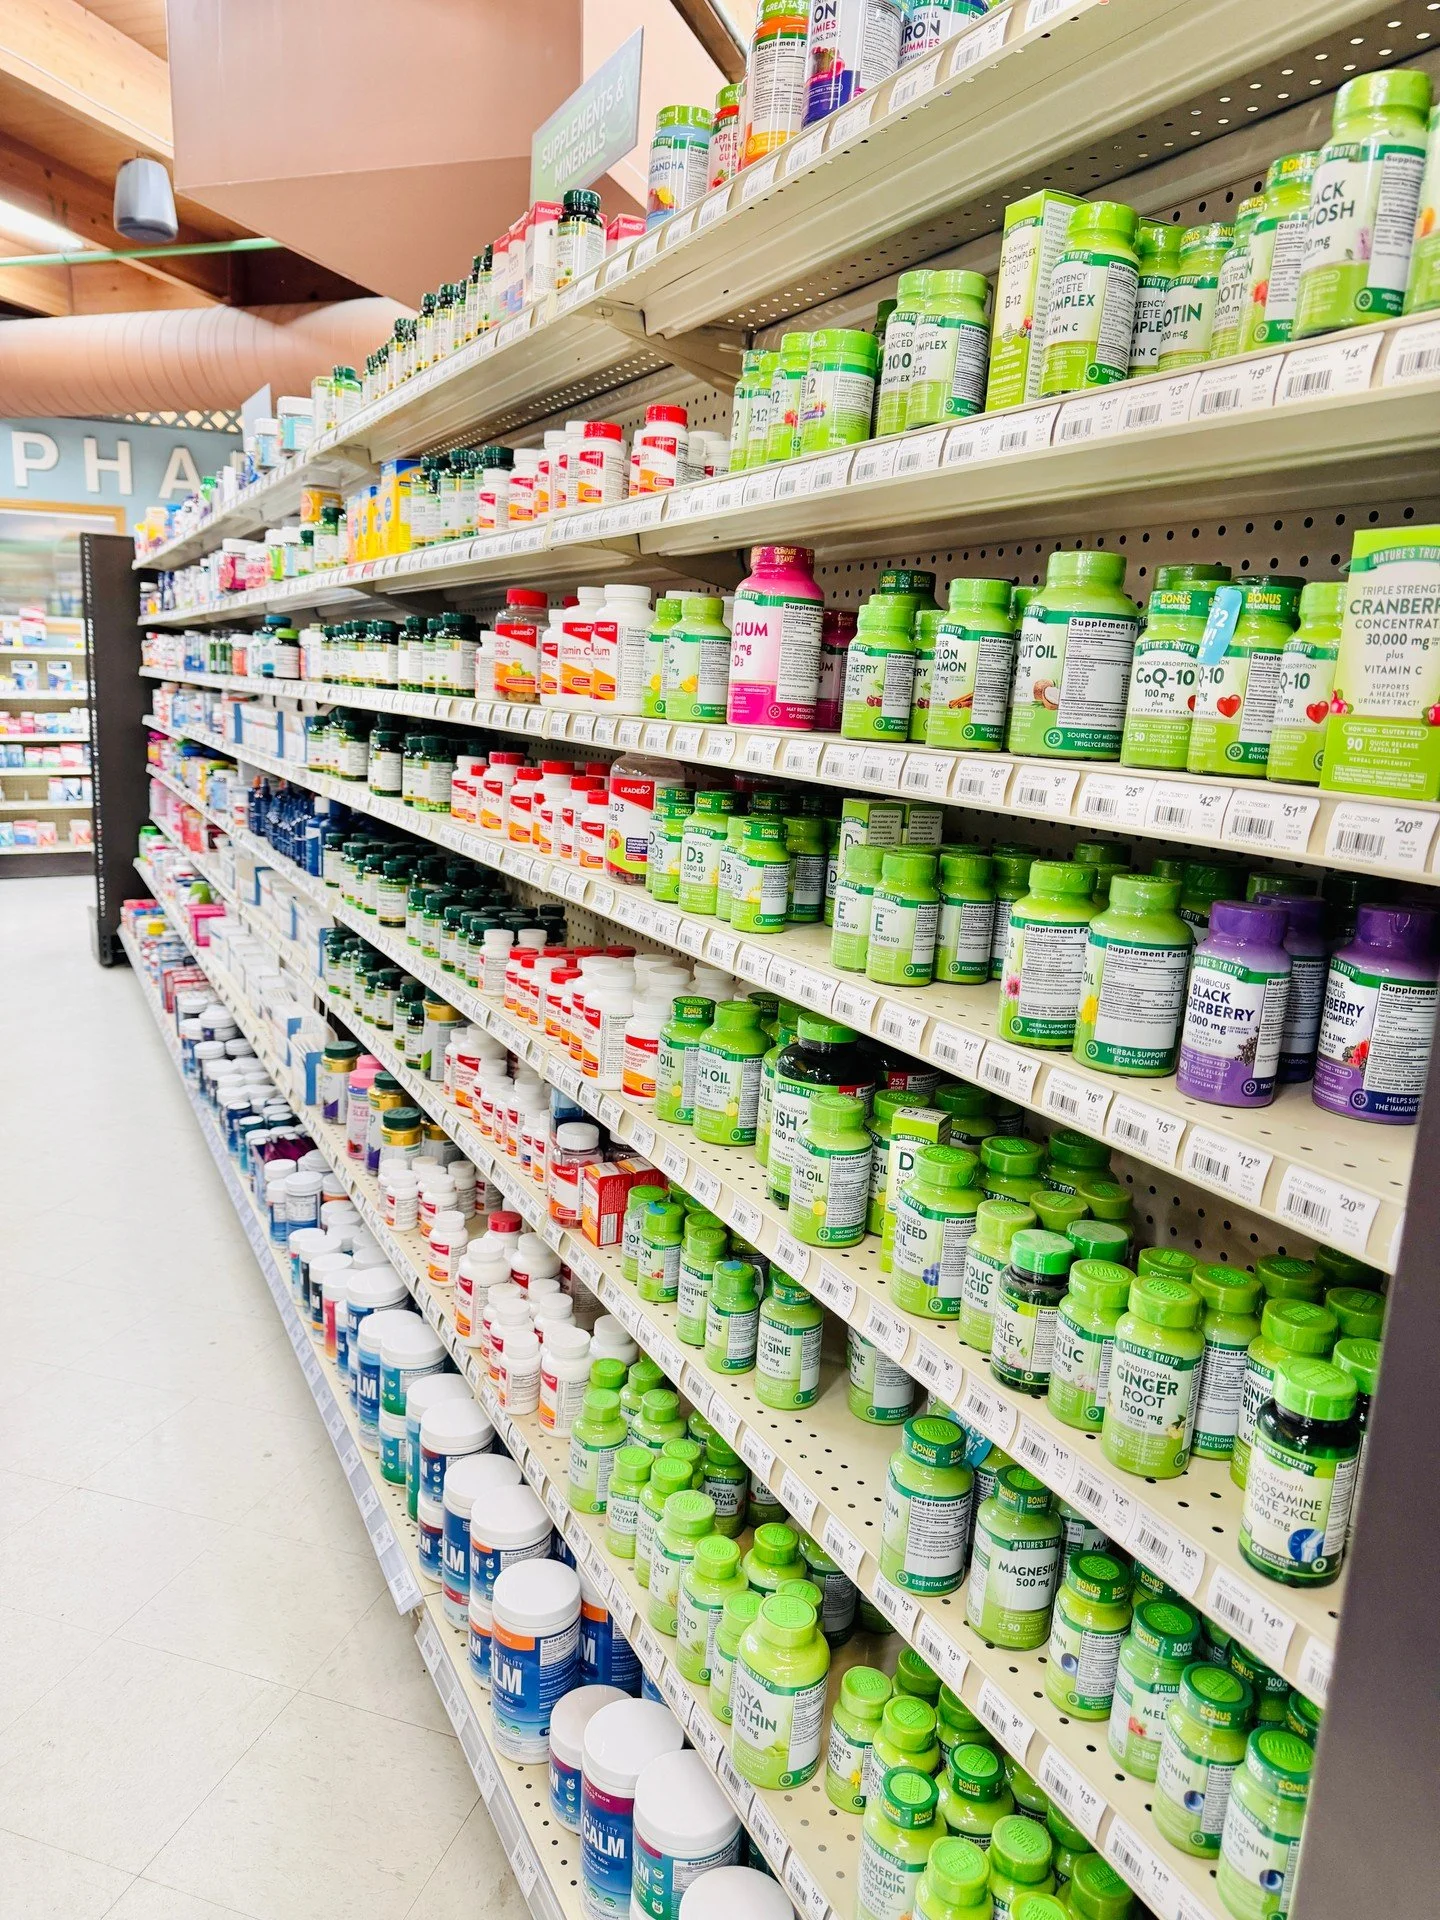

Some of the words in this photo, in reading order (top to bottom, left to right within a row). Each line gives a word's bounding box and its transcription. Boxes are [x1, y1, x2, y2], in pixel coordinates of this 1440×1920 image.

[900, 20, 941, 46] IRON
[900, 39, 941, 56] GUMMIES
[541, 86, 615, 171] SUPPLEMENTS
[614, 75, 626, 105] &
[554, 123, 607, 187] MINERALS
[1001, 246, 1037, 268] B-COMPLEX
[1004, 260, 1029, 277] LIQUID
[1004, 294, 1022, 309] B-12
[1373, 548, 1415, 565] NATURE'S
[1362, 586, 1394, 596] TRIPLE
[1160, 594, 1192, 605] BONUS
[1246, 594, 1282, 605] BONUS
[1071, 618, 1129, 632] Supplement
[739, 643, 753, 657] mg
[1141, 640, 1173, 654] NATURE'S
[1365, 633, 1408, 649] 30,000
[1410, 637, 1430, 652] mg
[1035, 645, 1058, 661] OIL
[1385, 650, 1404, 663] plus
[1161, 659, 1199, 669] ABSORPTION
[1364, 664, 1412, 677] VITAMIN
[1413, 667, 1423, 678] C
[1135, 667, 1195, 689] CoQ-10
[1371, 683, 1410, 692] SUPPORTS
[1143, 689, 1159, 700] 100
[1160, 690, 1176, 704] mg
[1358, 698, 1391, 706] URINARY
[1376, 692, 1410, 700] HEALTHY
[1067, 730, 1091, 741] SOURCE
[1092, 732, 1103, 741] OF
[1133, 731, 1146, 742] 50
[1346, 737, 1364, 752] 90
[1369, 740, 1391, 749] QUICK
[1391, 741, 1420, 751] RELEASE
[621, 787, 646, 796] LEADER
[686, 847, 704, 865] D3
[875, 913, 886, 933] E
[1026, 924, 1077, 937] Supplement
[1107, 944, 1165, 959] Supplement
[1218, 961, 1246, 978] TRUTH
[1195, 976, 1232, 991] SAMBUCUS
[1381, 983, 1438, 997] Supplement
[1192, 983, 1233, 1005] BLACK
[1210, 1023, 1228, 1037] mg
[1106, 1047, 1135, 1060] HERBAL
[1135, 1049, 1168, 1061] SUPPORT
[659, 1054, 676, 1070] OIL
[1113, 1056, 1131, 1067] FOR
[1131, 1057, 1160, 1069] WOMEN
[890, 1076, 907, 1087] 25%
[1386, 1095, 1407, 1105] HELPS
[1374, 1102, 1390, 1112] THE
[1390, 1103, 1417, 1114] IMMUNE
[805, 1170, 825, 1185] OIL
[965, 1276, 990, 1296] ACID
[760, 1341, 792, 1358] LYSINE
[1121, 1342, 1154, 1360] NATURE'S
[1153, 1349, 1181, 1367] TRUTH
[1122, 1358, 1172, 1381] TRADITIONAL
[1116, 1364, 1180, 1397] GINGER
[1121, 1386, 1165, 1410] ROOT
[1146, 1413, 1165, 1427] mg
[911, 1441, 938, 1460] BONUS
[912, 1496, 958, 1509] Supplement
[612, 1507, 639, 1519] PAPAYA
[1282, 1503, 1318, 1523] 2KCL
[1273, 1517, 1292, 1533] mg
[1014, 1540, 1045, 1551] NATURE'S
[911, 1579, 943, 1590] ESSENTIAL
[1016, 1577, 1037, 1588] 500
[1037, 1579, 1050, 1590] mg
[1076, 1579, 1102, 1595] BONUS
[1141, 1570, 1165, 1590] BONUS
[1006, 1622, 1021, 1634] 90
[1172, 1641, 1193, 1655] 100%
[1200, 1705, 1232, 1722] BONUS
[745, 1725, 760, 1741] mg
[1141, 1750, 1157, 1763] 180
[957, 1778, 981, 1794] BONUS
[583, 1816, 625, 1860] CALM
